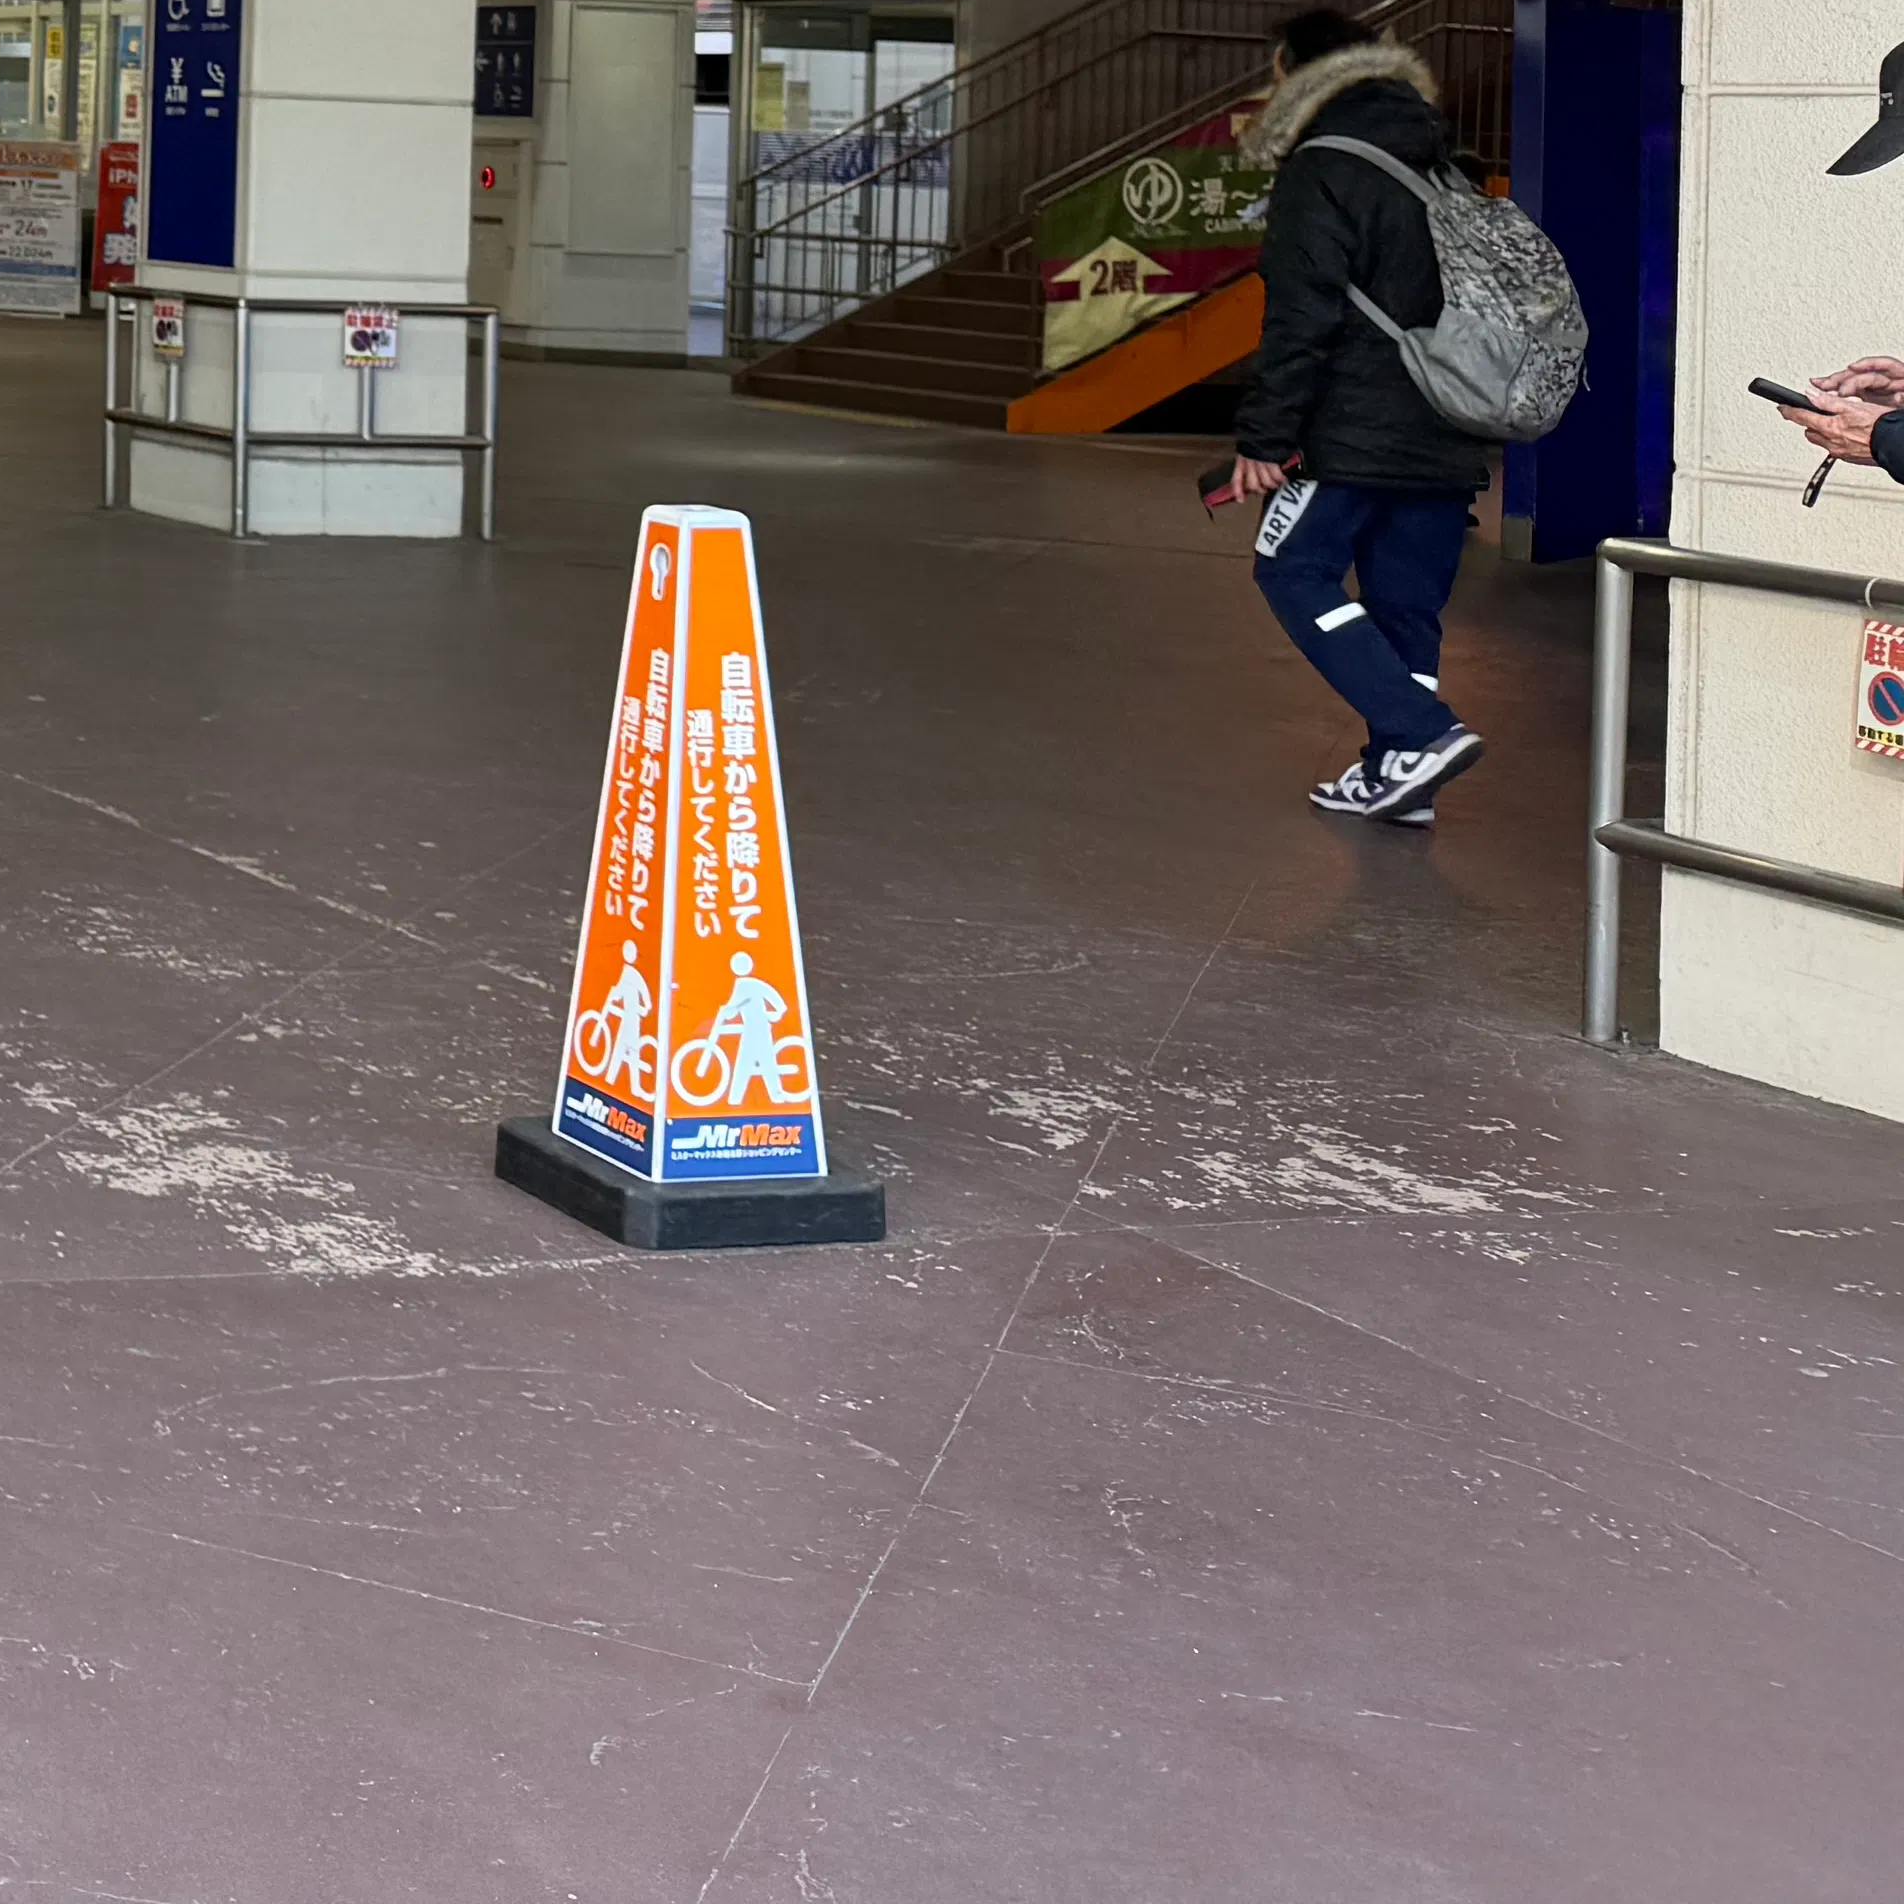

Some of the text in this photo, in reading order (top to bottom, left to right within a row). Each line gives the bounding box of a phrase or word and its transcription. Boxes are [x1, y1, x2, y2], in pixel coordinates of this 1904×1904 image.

[165, 85, 188, 103] ATM
[1090, 259, 1138, 294] 2階
[1263, 504, 1292, 547] ART
[605, 695, 642, 917] 通行してください
[627, 647, 671, 932] 自転車から降りて
[720, 651, 762, 940] 自転車から降りて
[687, 709, 722, 938] 通行してください
[566, 1093, 647, 1144] MrMax
[671, 1124, 801, 1150] MrMax
